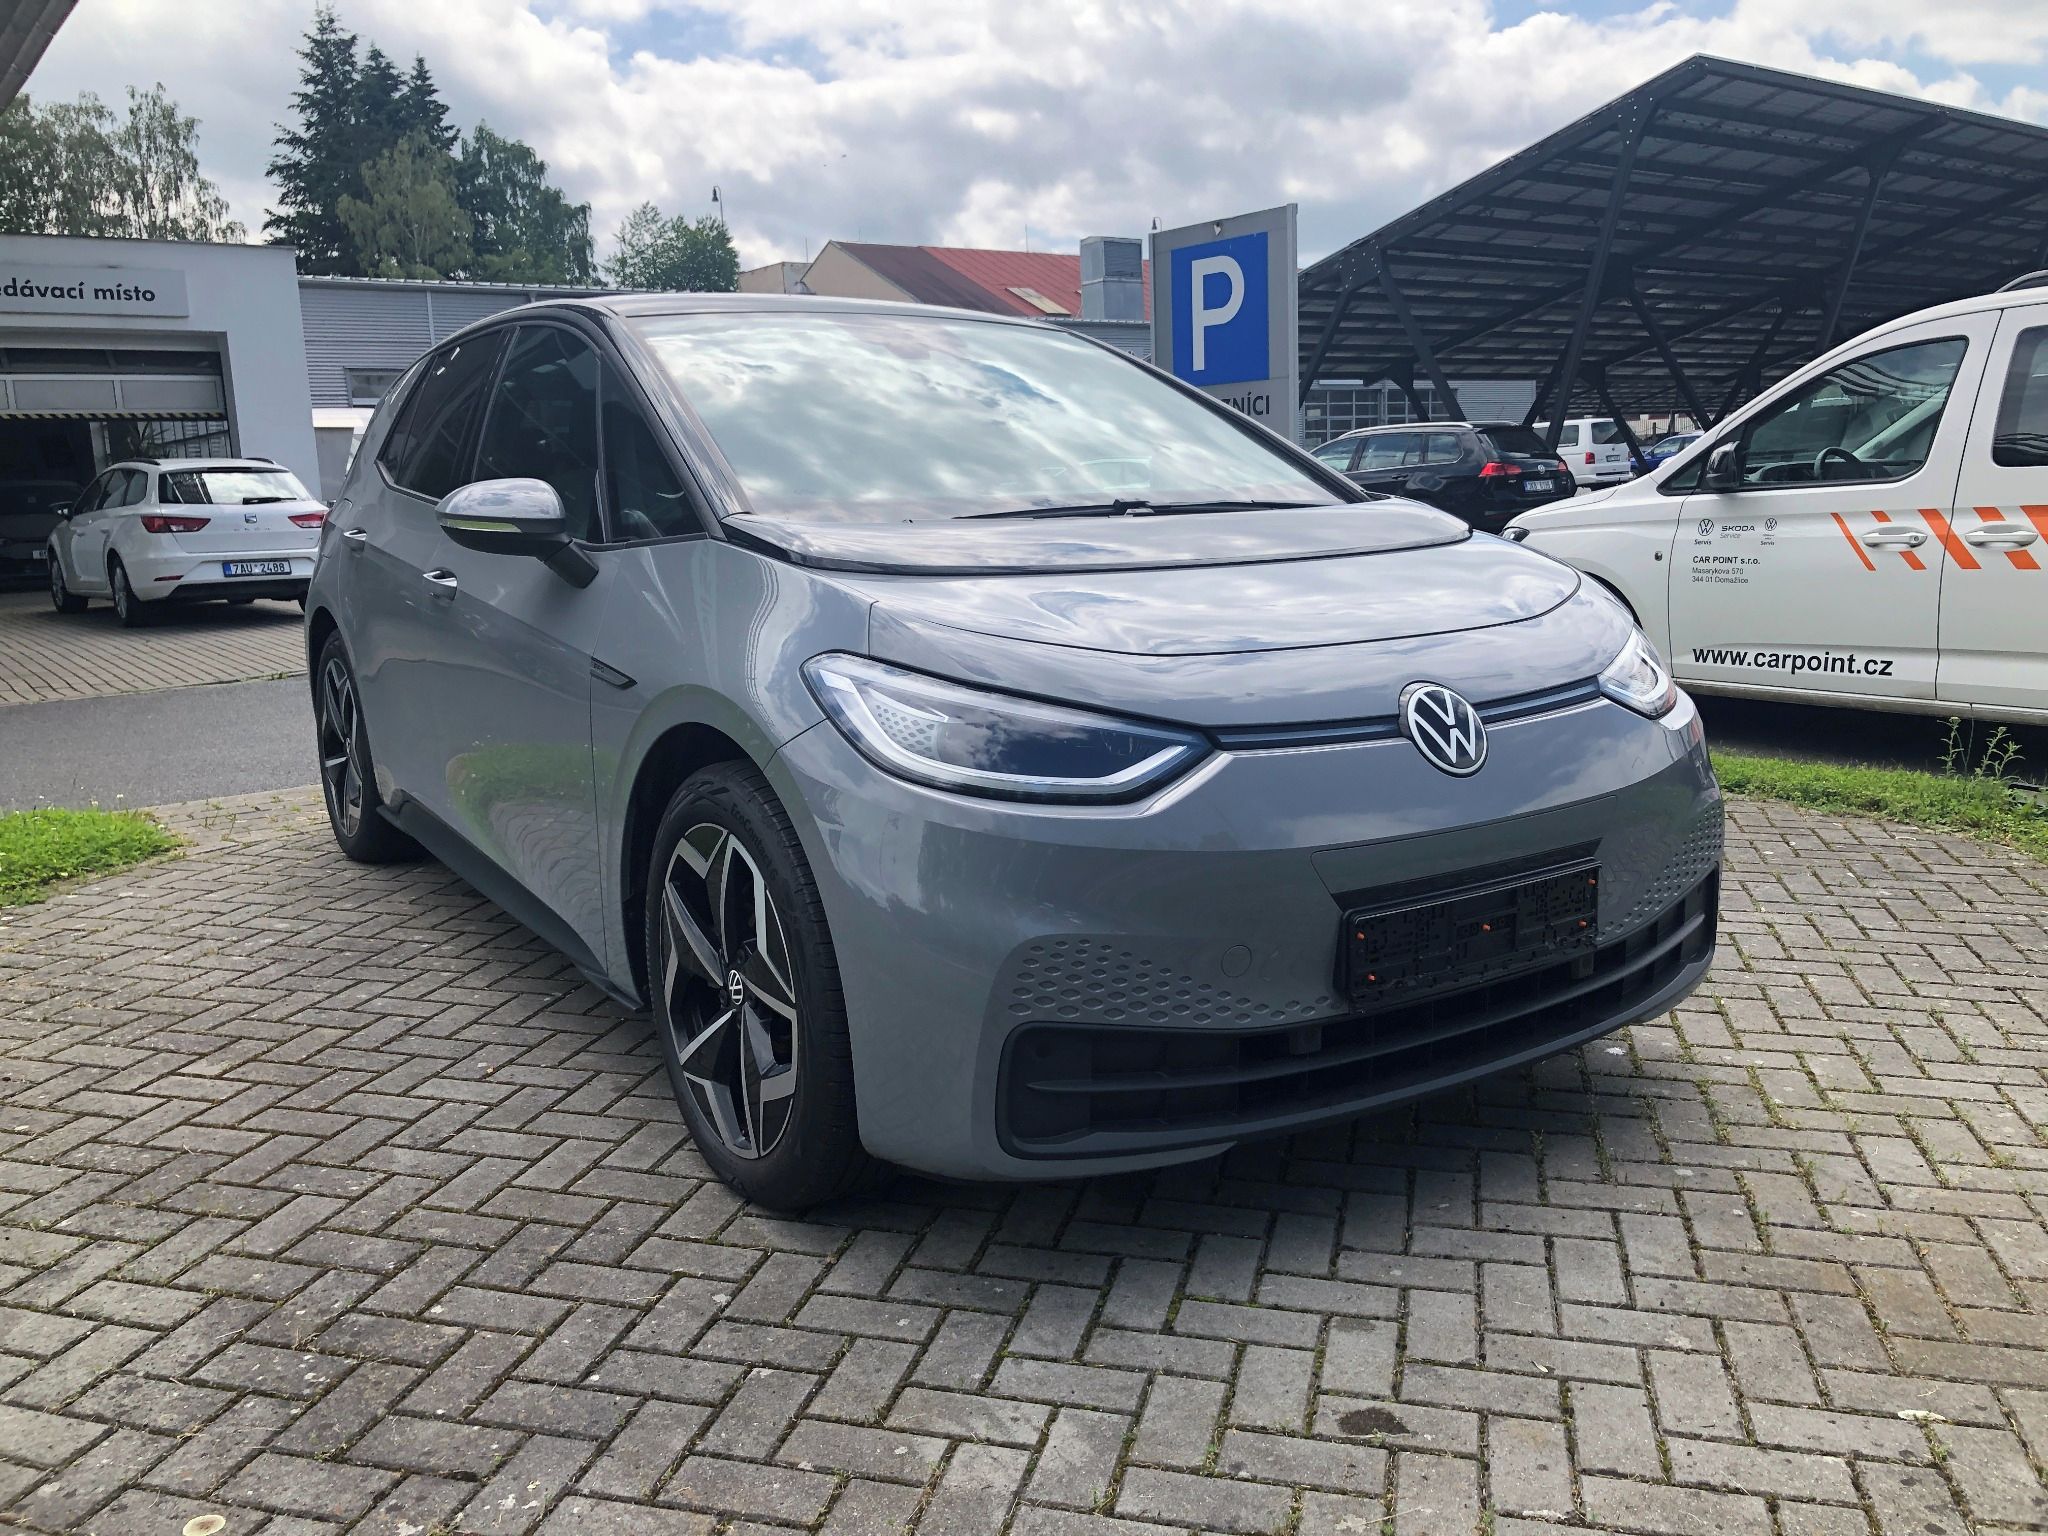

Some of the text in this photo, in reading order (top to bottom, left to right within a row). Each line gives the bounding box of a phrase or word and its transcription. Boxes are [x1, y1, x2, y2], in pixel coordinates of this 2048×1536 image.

[0, 277, 156, 302] dávací místo
[1192, 255, 1245, 372] P
[1692, 555, 1711, 564] CAR
[1712, 556, 1739, 565] POINT
[233, 563, 253, 574] 7AU
[1692, 566, 1744, 576] Masarykova 570
[1691, 575, 1749, 584] 344 01 Domažlice
[1692, 647, 1894, 676] www.carpoint.cz
